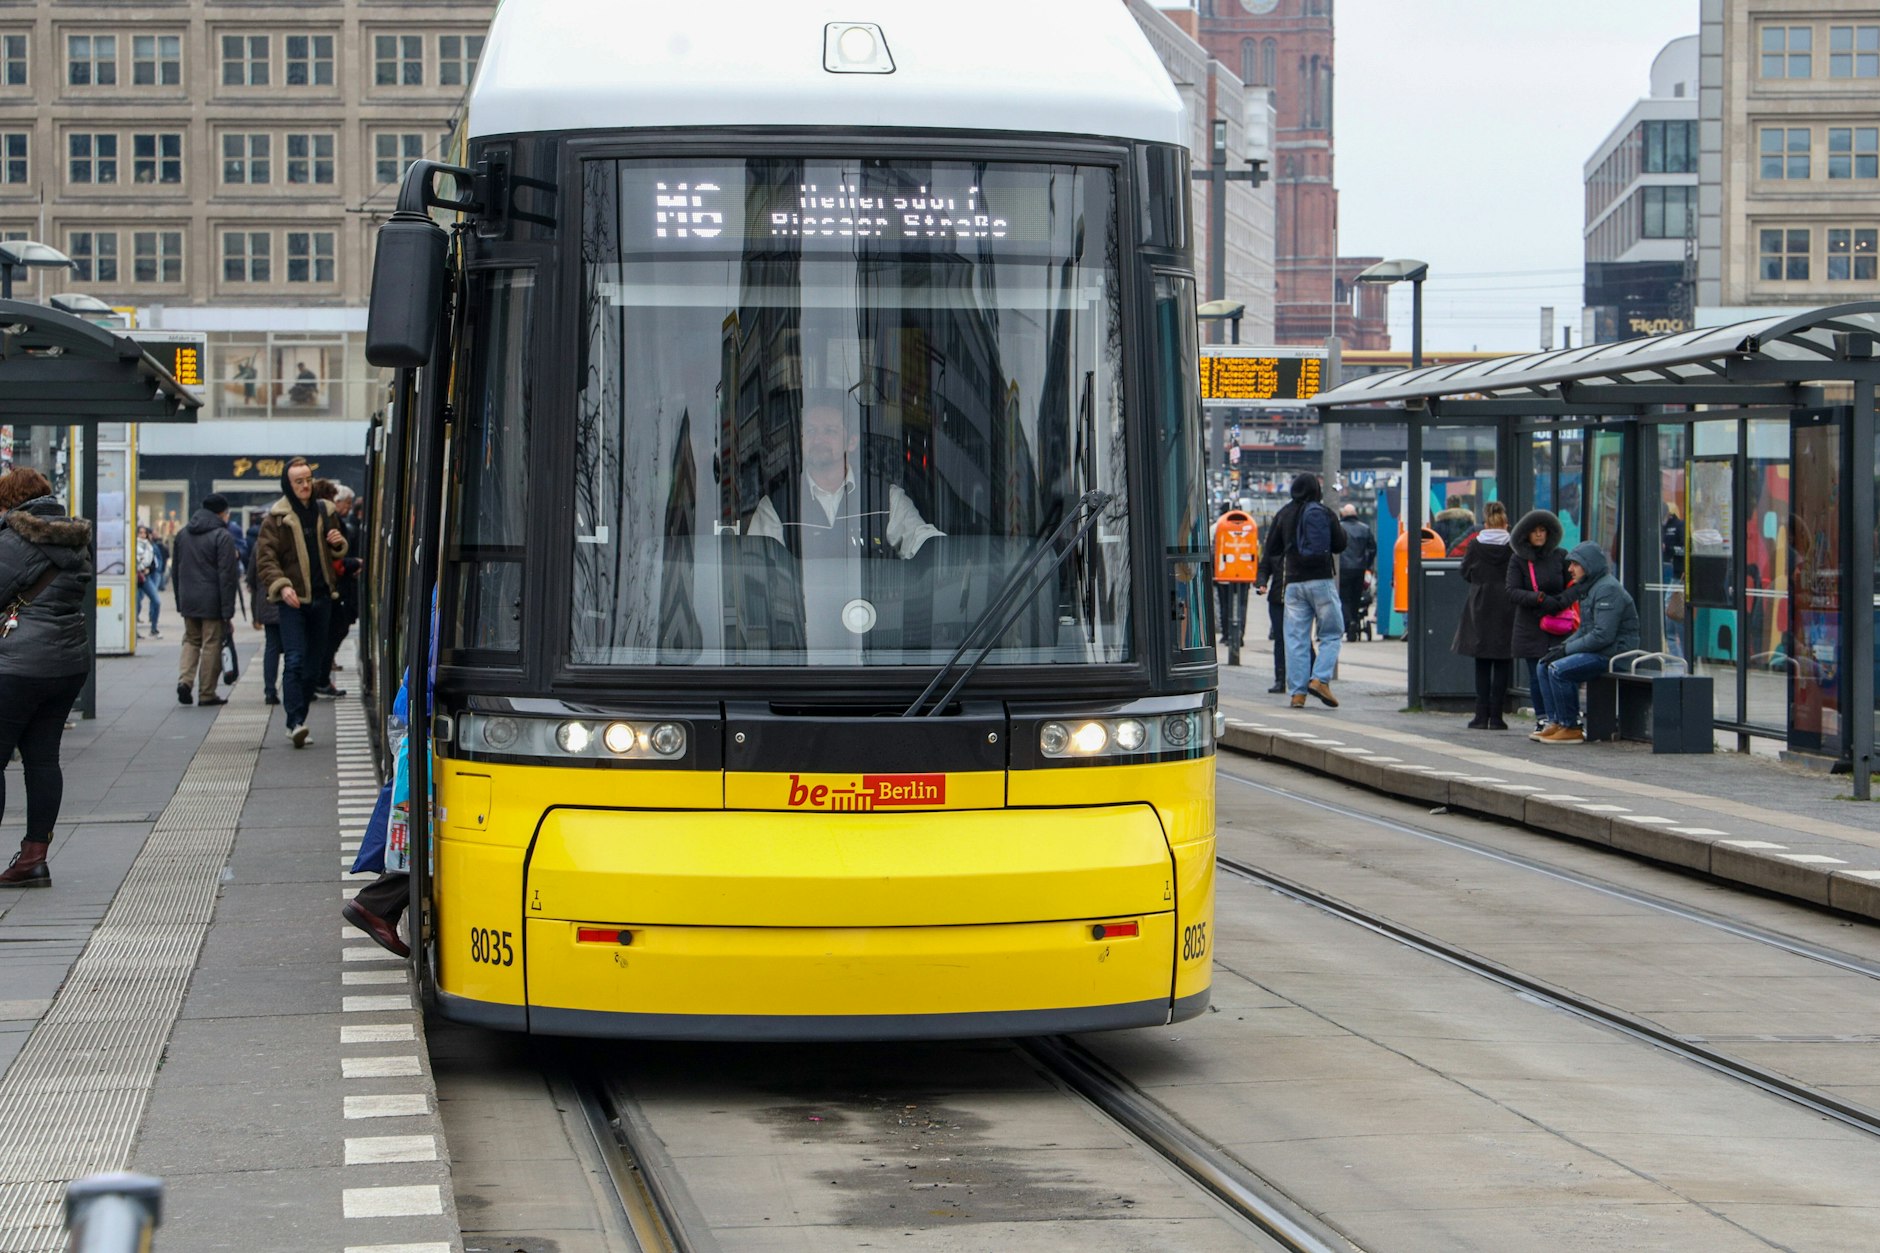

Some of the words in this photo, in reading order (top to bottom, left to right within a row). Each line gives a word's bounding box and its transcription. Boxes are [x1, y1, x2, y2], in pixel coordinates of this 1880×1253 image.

[657, 183, 722, 237] M6
[788, 774, 829, 806] be
[879, 781, 938, 800] Berlin
[471, 927, 513, 967] 8035
[1183, 922, 1206, 961] 8035
